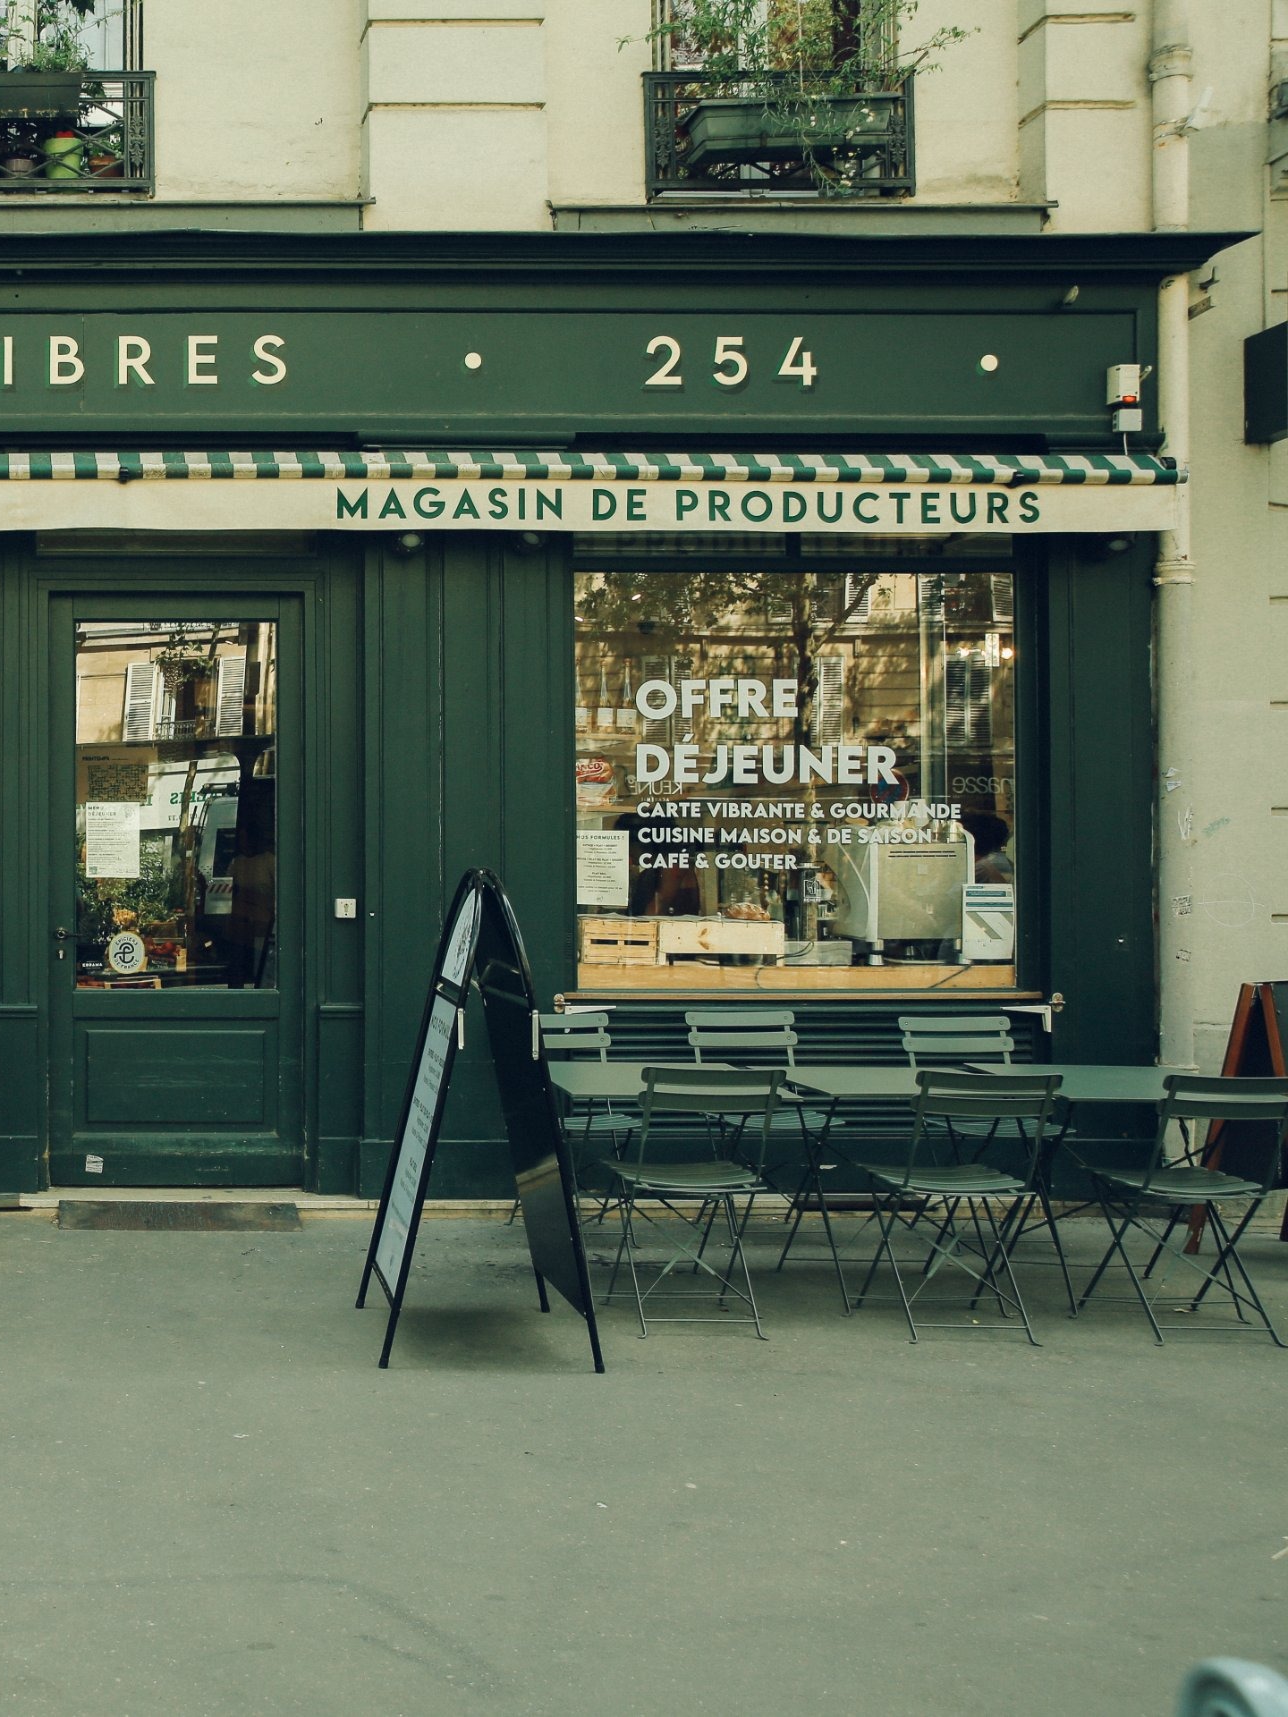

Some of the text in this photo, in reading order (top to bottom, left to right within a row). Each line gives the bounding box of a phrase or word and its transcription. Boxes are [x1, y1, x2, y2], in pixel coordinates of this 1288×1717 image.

[644, 335, 818, 386] 254
[336, 484, 1041, 525] MAGASIN DE PRODUCTEURS
[635, 678, 799, 720] OFFRE
[636, 734, 900, 786] DÉJEUNER
[636, 802, 961, 819] CARTE VIBRANTE & GOURMANDE
[637, 827, 932, 844] CUISINE MAISON & DE SAISON
[638, 849, 690, 869] CAFÉ
[694, 853, 709, 870] &
[714, 853, 798, 870] GOUTER
